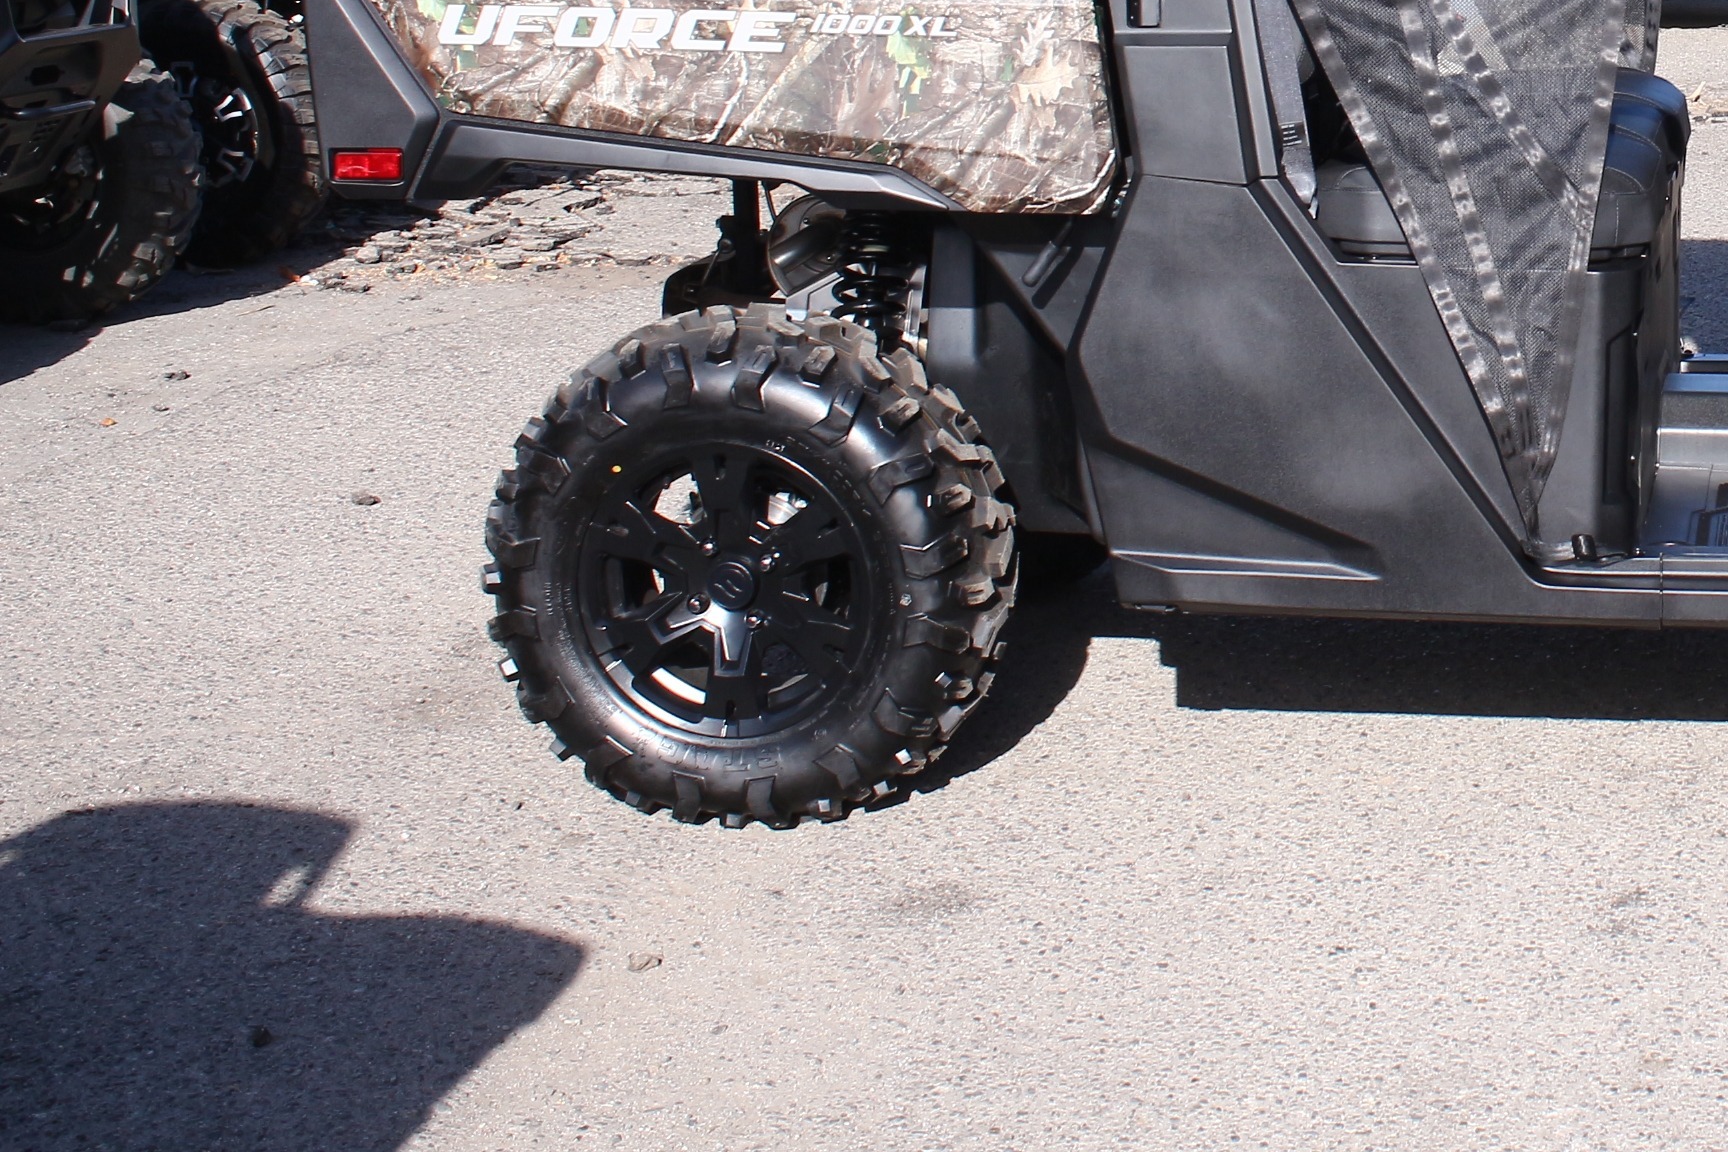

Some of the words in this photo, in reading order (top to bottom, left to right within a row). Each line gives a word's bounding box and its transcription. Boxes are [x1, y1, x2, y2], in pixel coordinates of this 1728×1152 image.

[440, 5, 797, 53] UFORCE
[809, 14, 901, 36] 1000
[902, 16, 958, 38] XL
